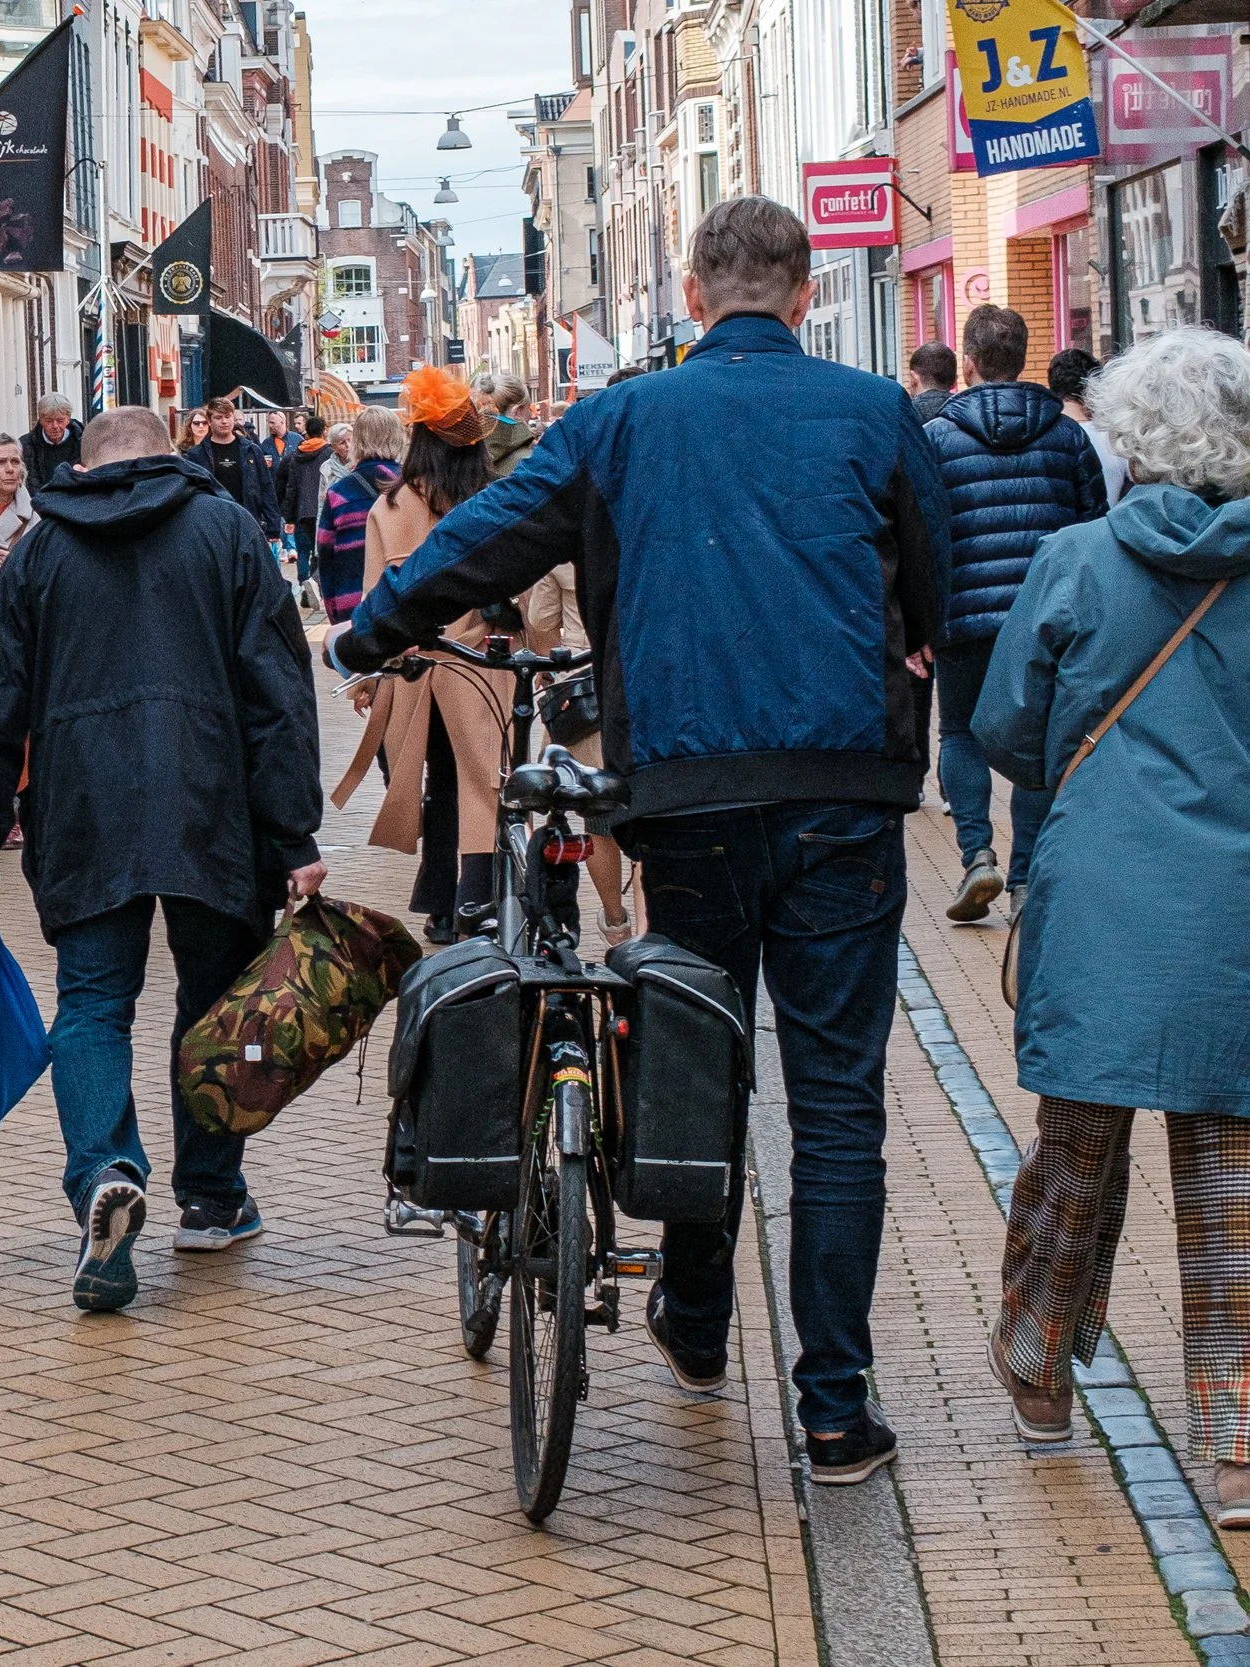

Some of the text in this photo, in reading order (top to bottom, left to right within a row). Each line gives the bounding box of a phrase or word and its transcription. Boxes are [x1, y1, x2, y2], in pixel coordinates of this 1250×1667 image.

[985, 86, 1072, 113] JZ-HANDMADE.NL
[16, 144, 48, 154] chocolade
[986, 122, 1086, 165] HANDMADE
